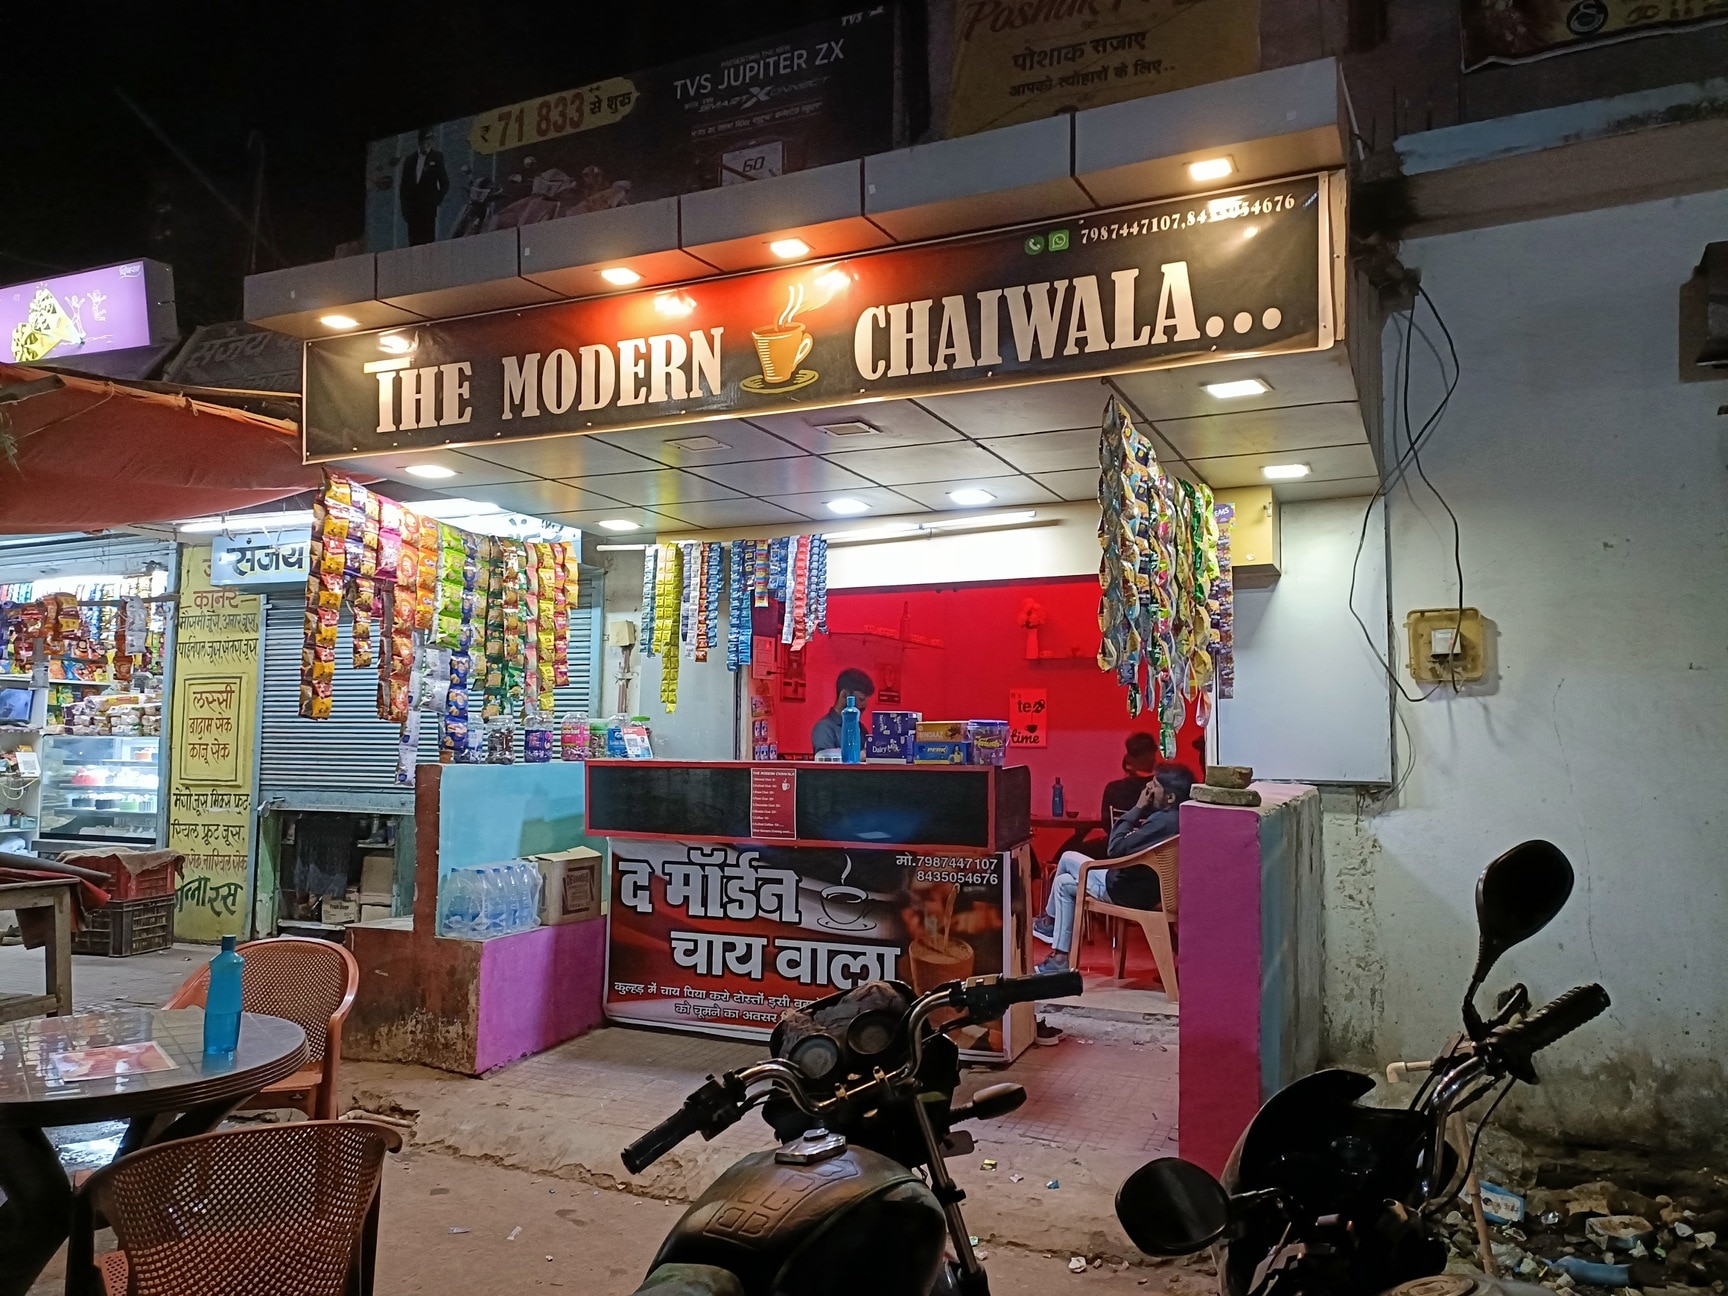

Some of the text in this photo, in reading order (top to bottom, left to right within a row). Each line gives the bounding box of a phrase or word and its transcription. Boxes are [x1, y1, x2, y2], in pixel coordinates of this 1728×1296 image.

[674, 38, 845, 99] TVS JUPITER ZX
[1011, 42, 1087, 71] पोशाक
[1113, 62, 1128, 78] के
[498, 108, 525, 147] 71
[536, 92, 585, 137] 833
[363, 356, 473, 433] THE
[501, 327, 725, 420] MODERN
[226, 537, 304, 576] संजय
[193, 684, 235, 712] लस्सी
[1011, 729, 1040, 744] time
[618, 861, 653, 913] द
[917, 871, 998, 885] 8435054676
[208, 881, 243, 917] रस
[670, 931, 901, 991] चाय वाला
[648, 982, 657, 994] में
[660, 986, 680, 997] चाय
[684, 985, 706, 999] पिया
[709, 989, 730, 1001] करो
[733, 989, 765, 1005] दोस्तों
[768, 994, 790, 1008] इसी
[675, 1001, 691, 1014] को
[693, 1003, 720, 1019] चूमने
[724, 1008, 739, 1019] का
[742, 1011, 778, 1022] अवसर
